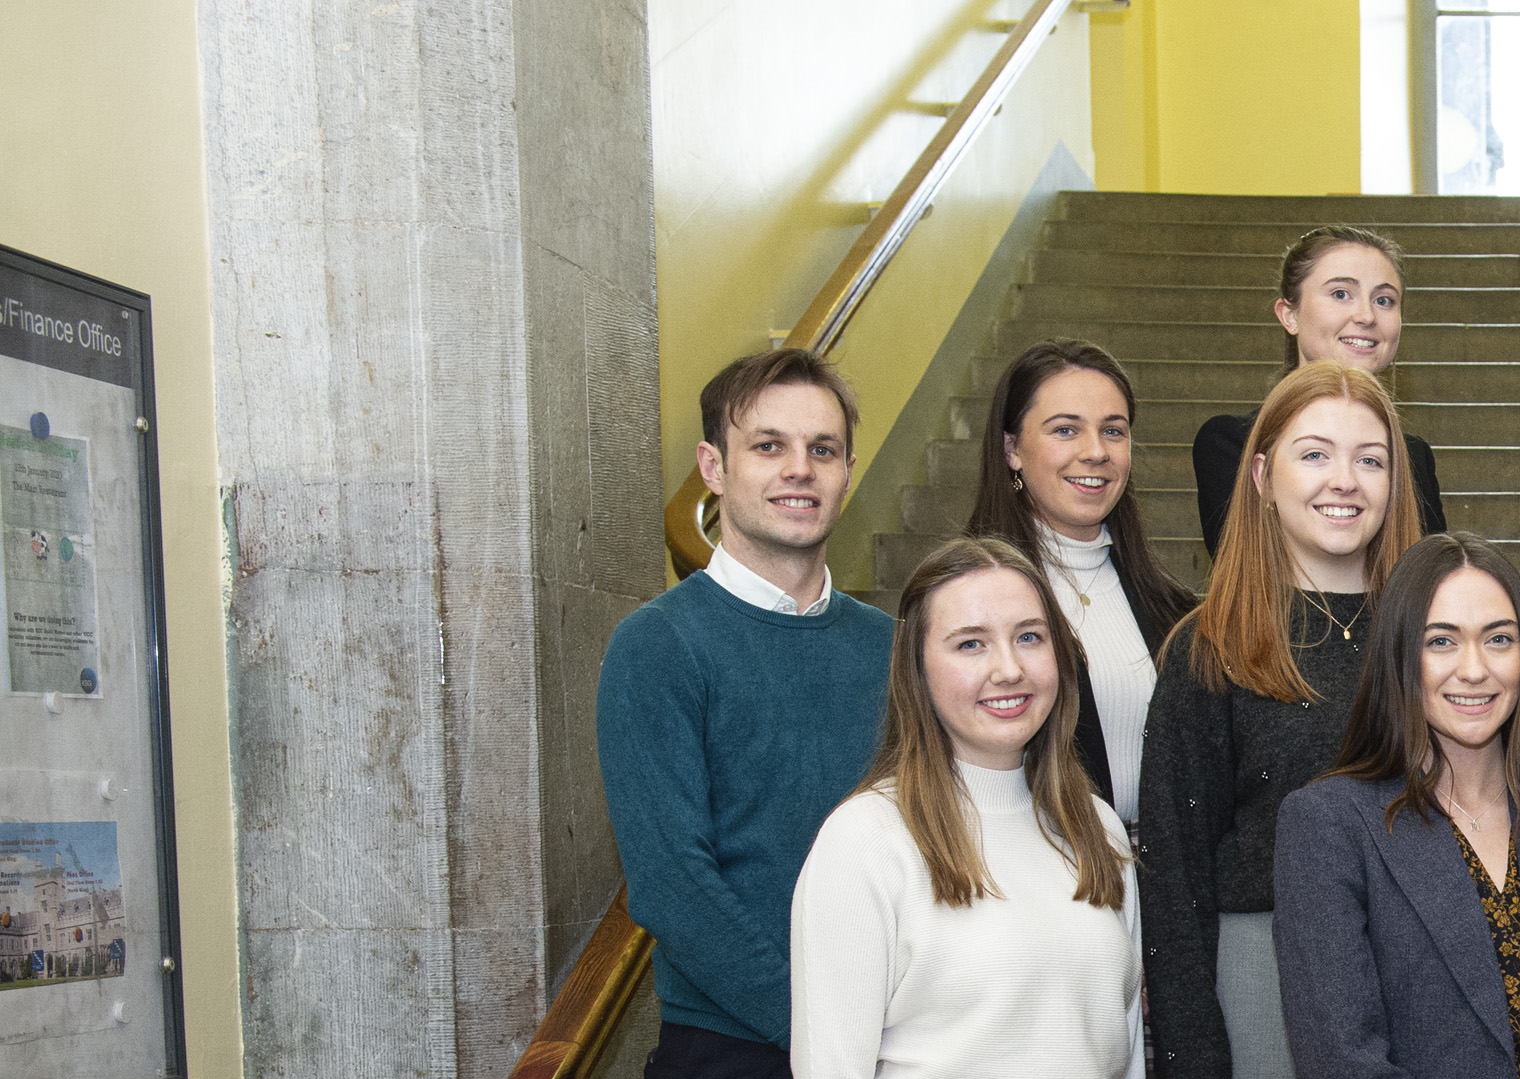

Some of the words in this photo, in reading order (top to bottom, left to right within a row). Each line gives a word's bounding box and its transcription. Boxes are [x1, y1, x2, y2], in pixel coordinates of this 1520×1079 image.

[78, 320, 121, 357] Office
[14, 612, 26, 624] Why
[47, 615, 61, 627] doing
[62, 617, 76, 626] this?
